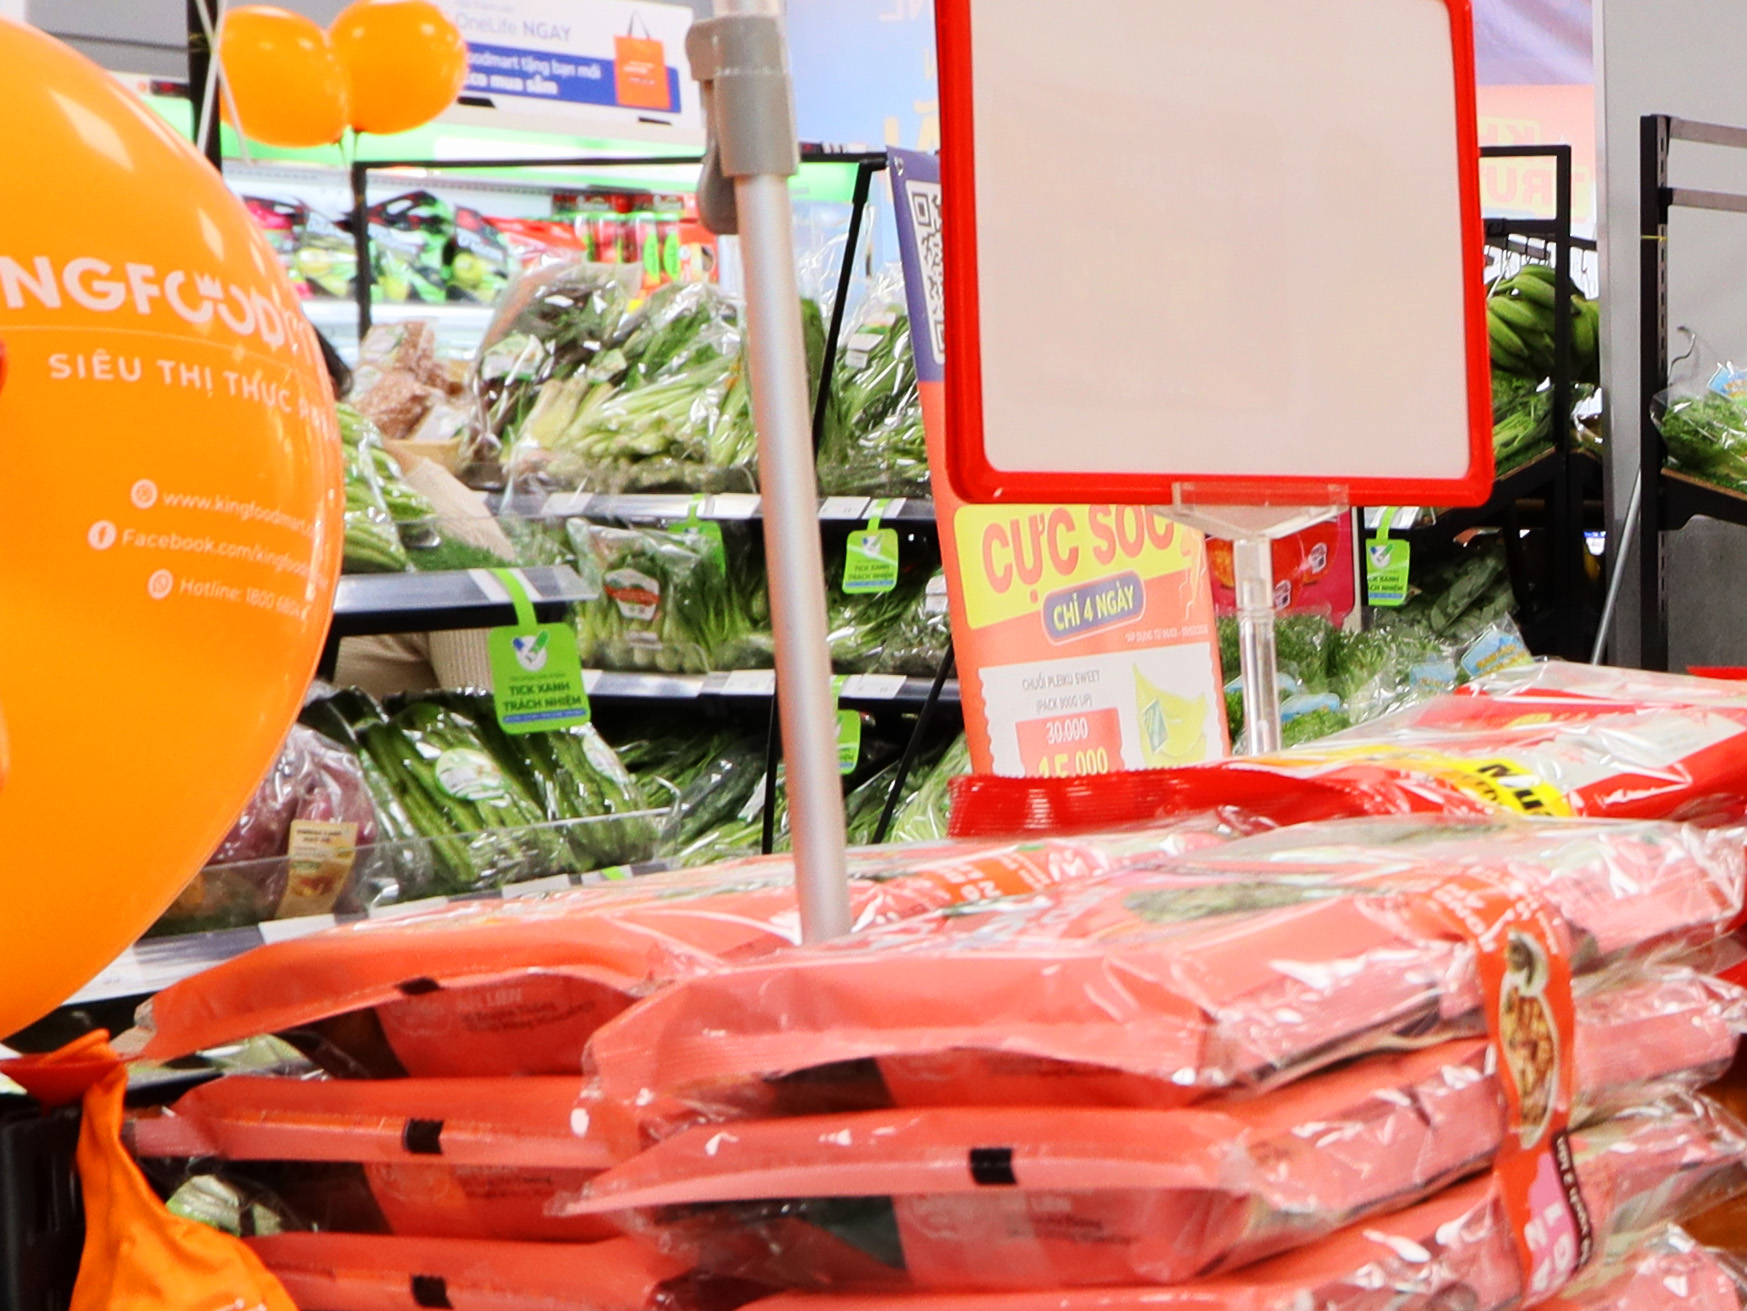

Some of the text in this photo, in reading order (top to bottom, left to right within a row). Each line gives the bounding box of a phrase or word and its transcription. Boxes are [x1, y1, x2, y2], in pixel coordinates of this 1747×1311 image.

[49, 348, 294, 414] SIÊU THỊ THỰC
[982, 511, 1079, 604] CỰC
[1053, 583, 1135, 631] CHỈ 4 NGÀY
